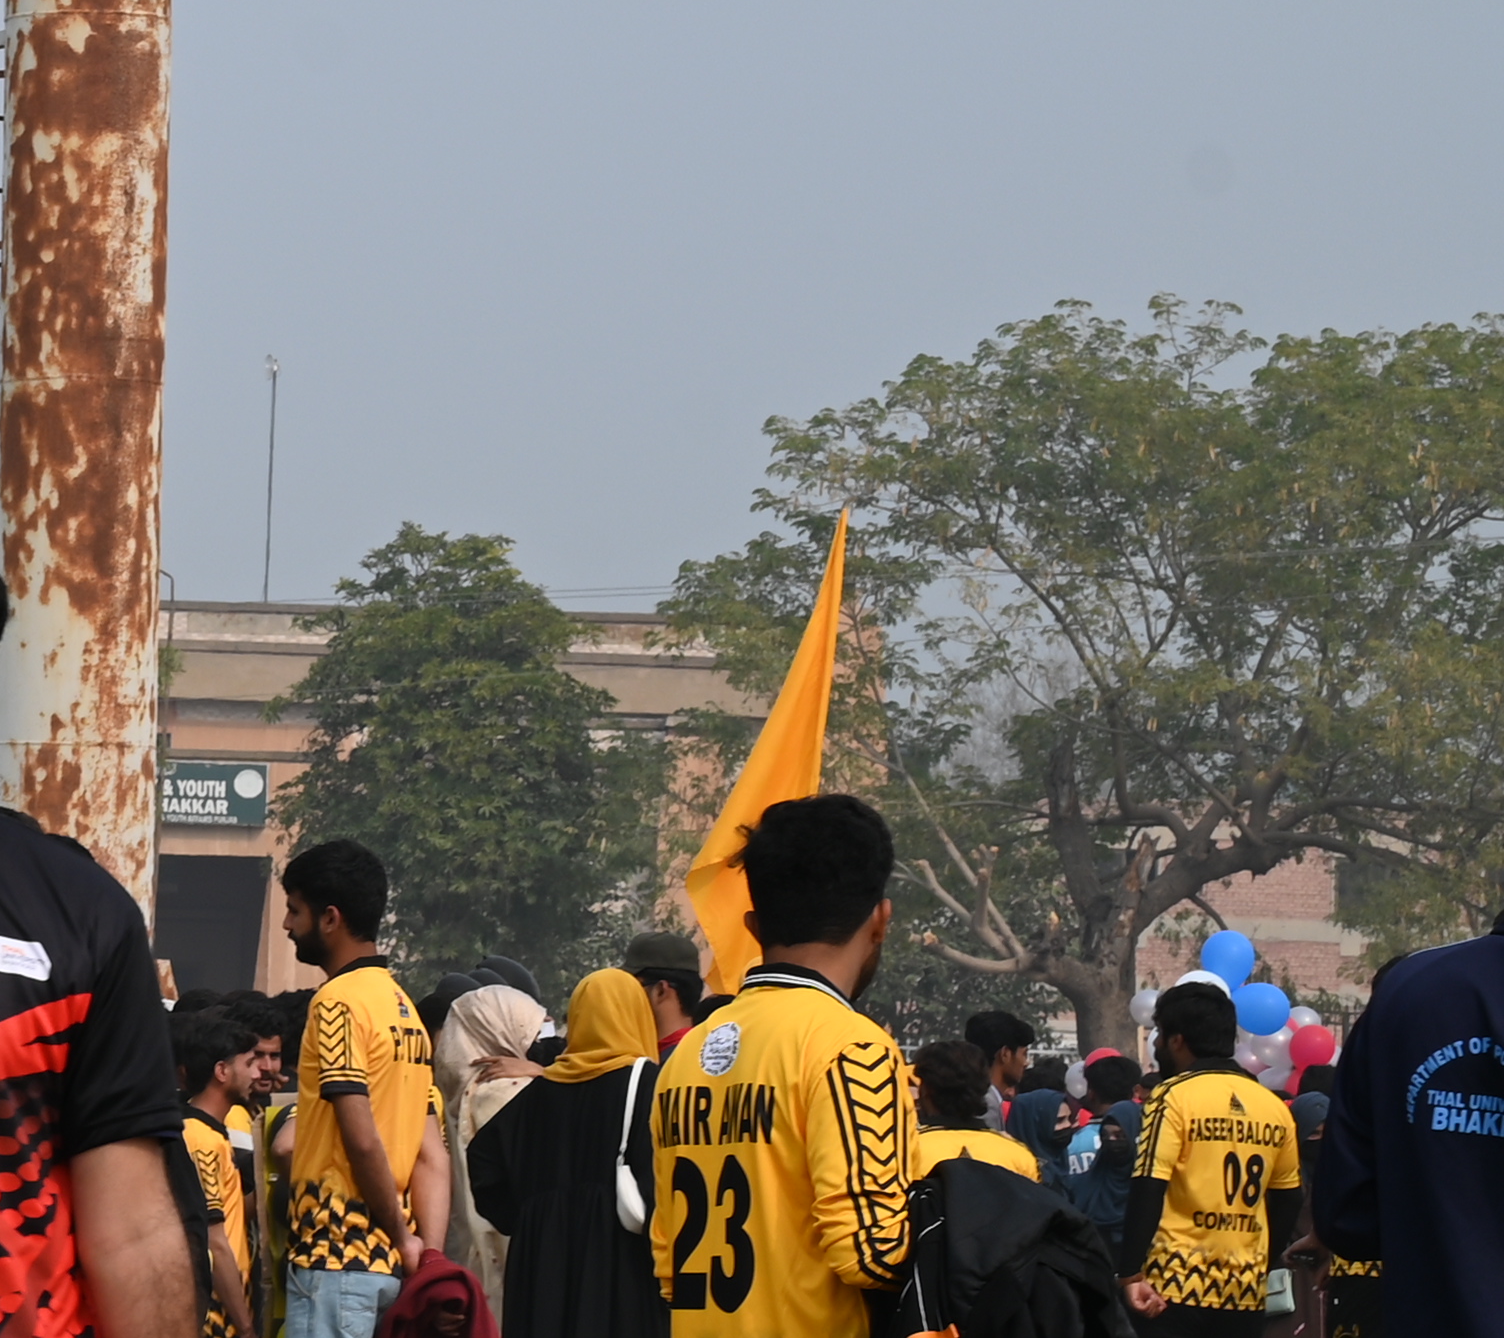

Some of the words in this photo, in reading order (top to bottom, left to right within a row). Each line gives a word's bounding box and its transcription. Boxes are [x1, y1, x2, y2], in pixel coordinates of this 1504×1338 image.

[177, 779, 227, 798] YOUTH
[1469, 1037, 1491, 1055] OF
[1427, 1089, 1465, 1109] THAL
[1188, 1117, 1234, 1142] FASEEH
[1223, 1150, 1265, 1208] 08
[671, 1154, 755, 1314] 23
